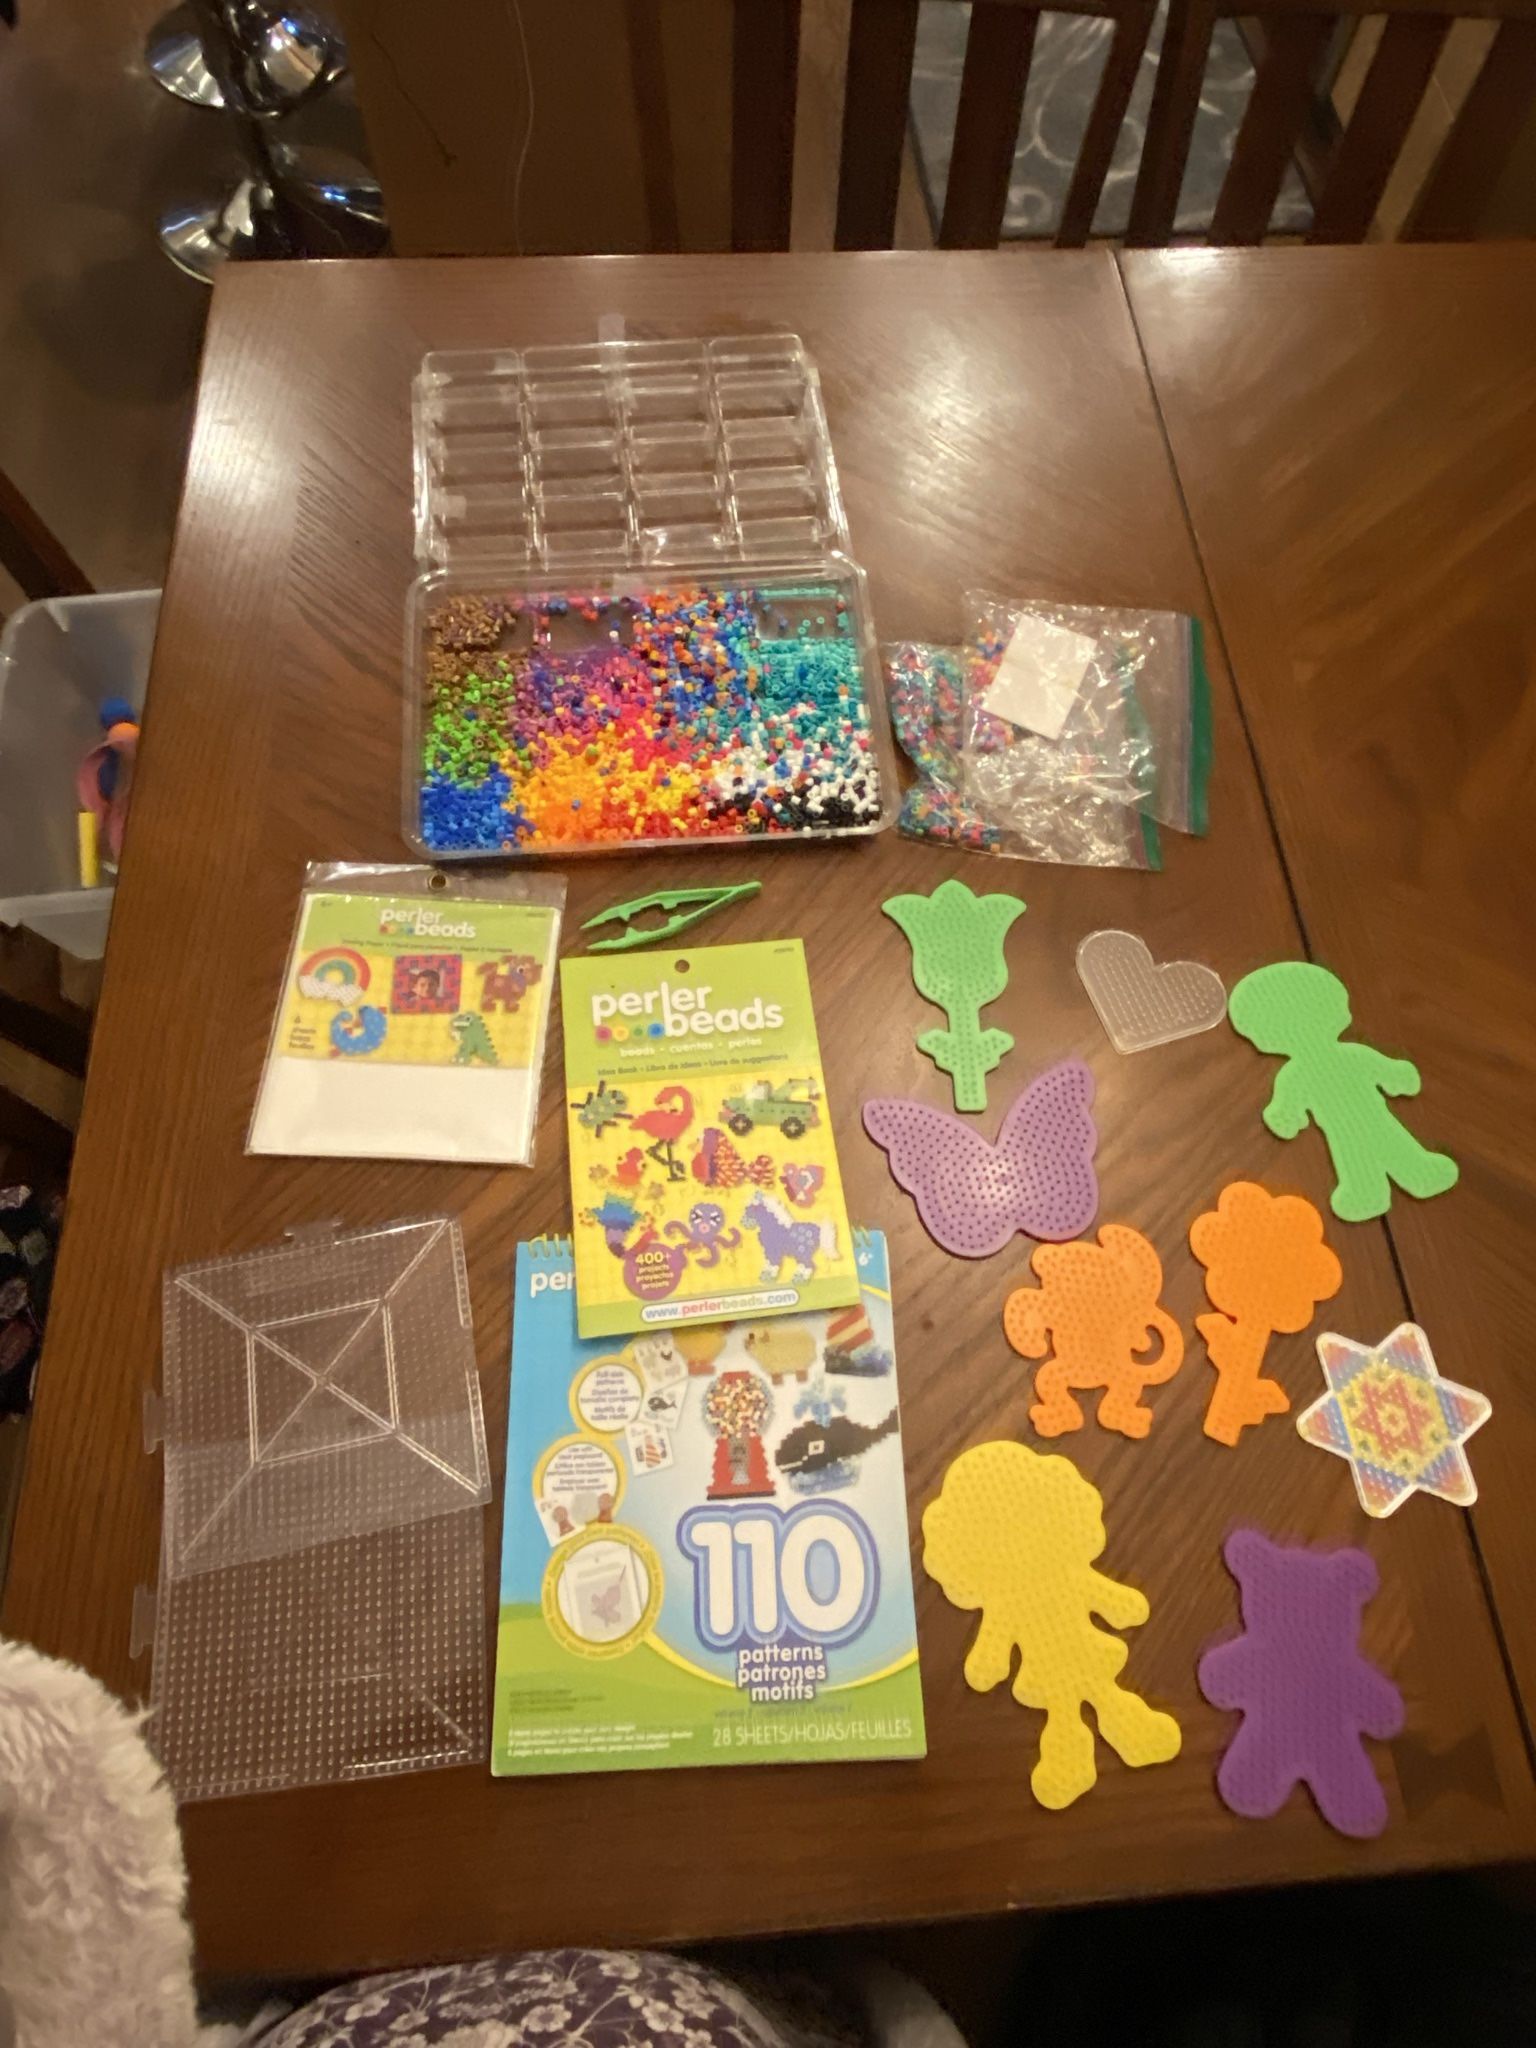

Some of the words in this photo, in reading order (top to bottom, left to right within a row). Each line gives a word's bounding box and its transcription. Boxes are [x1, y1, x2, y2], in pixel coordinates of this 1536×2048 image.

[380, 907, 444, 925] perler
[415, 922, 477, 938] beads
[591, 981, 713, 1026] perler
[662, 997, 785, 1037] beads
[619, 1045, 656, 1058] beads
[635, 1251, 672, 1265] 400+
[644, 1292, 797, 1319] www.perlerbeads.com
[687, 1511, 868, 1638] 110
[738, 1643, 825, 1669] patterns
[737, 1663, 827, 1689] patrones
[750, 1679, 815, 1702] motifs
[712, 1725, 732, 1747] 28
